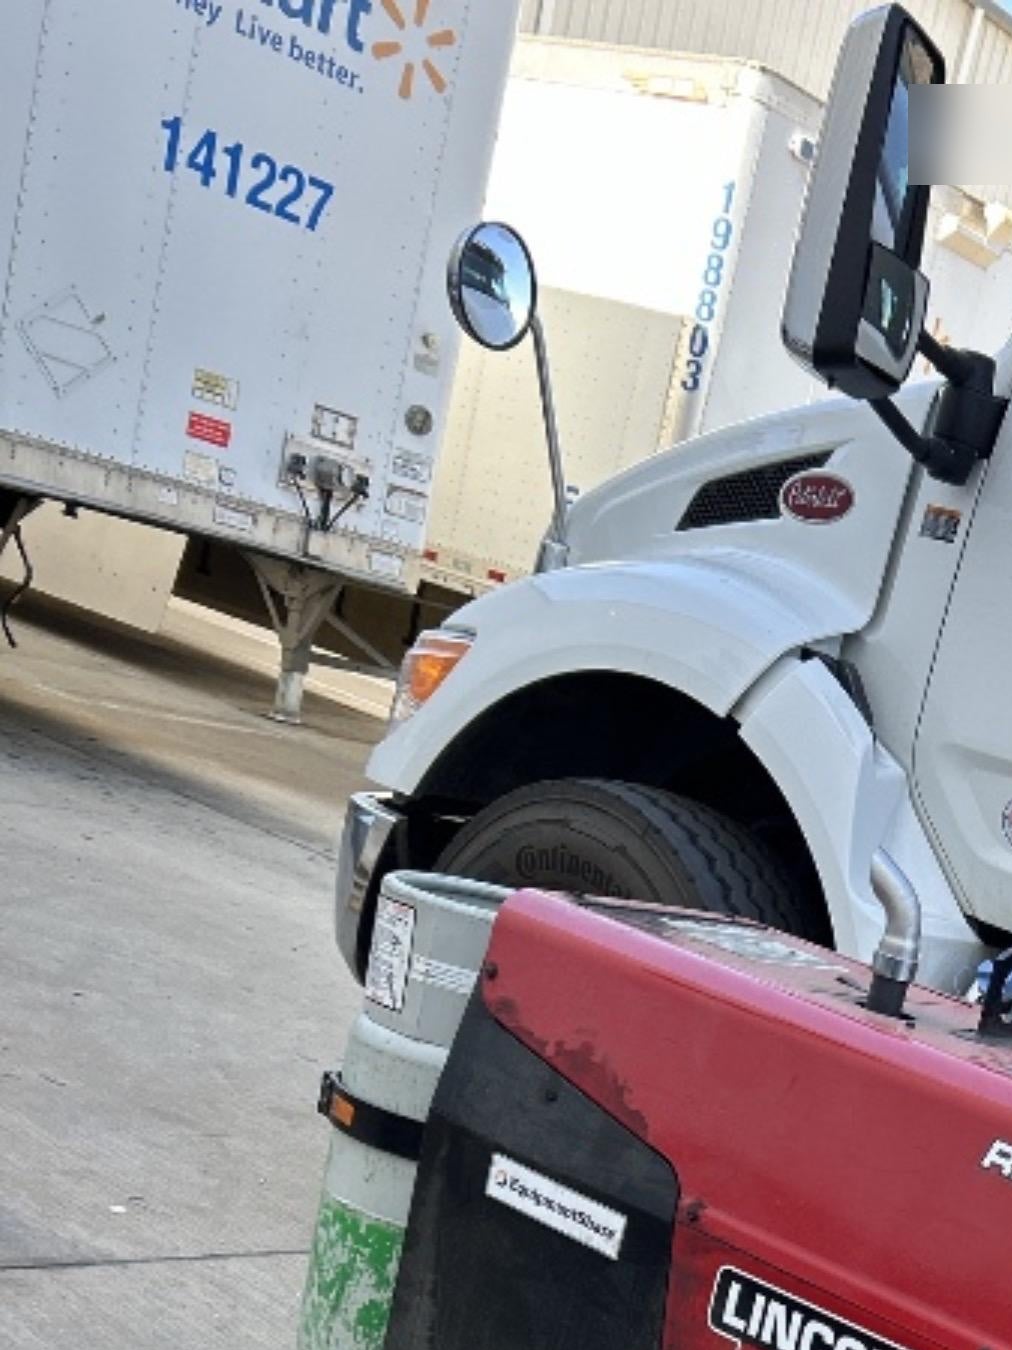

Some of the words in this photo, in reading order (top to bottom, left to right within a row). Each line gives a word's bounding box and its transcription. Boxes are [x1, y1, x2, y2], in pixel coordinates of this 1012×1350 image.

[235, 8, 283, 53] Live
[288, 35, 364, 94] better.
[161, 116, 335, 231] 141227
[681, 180, 736, 391] 198803
